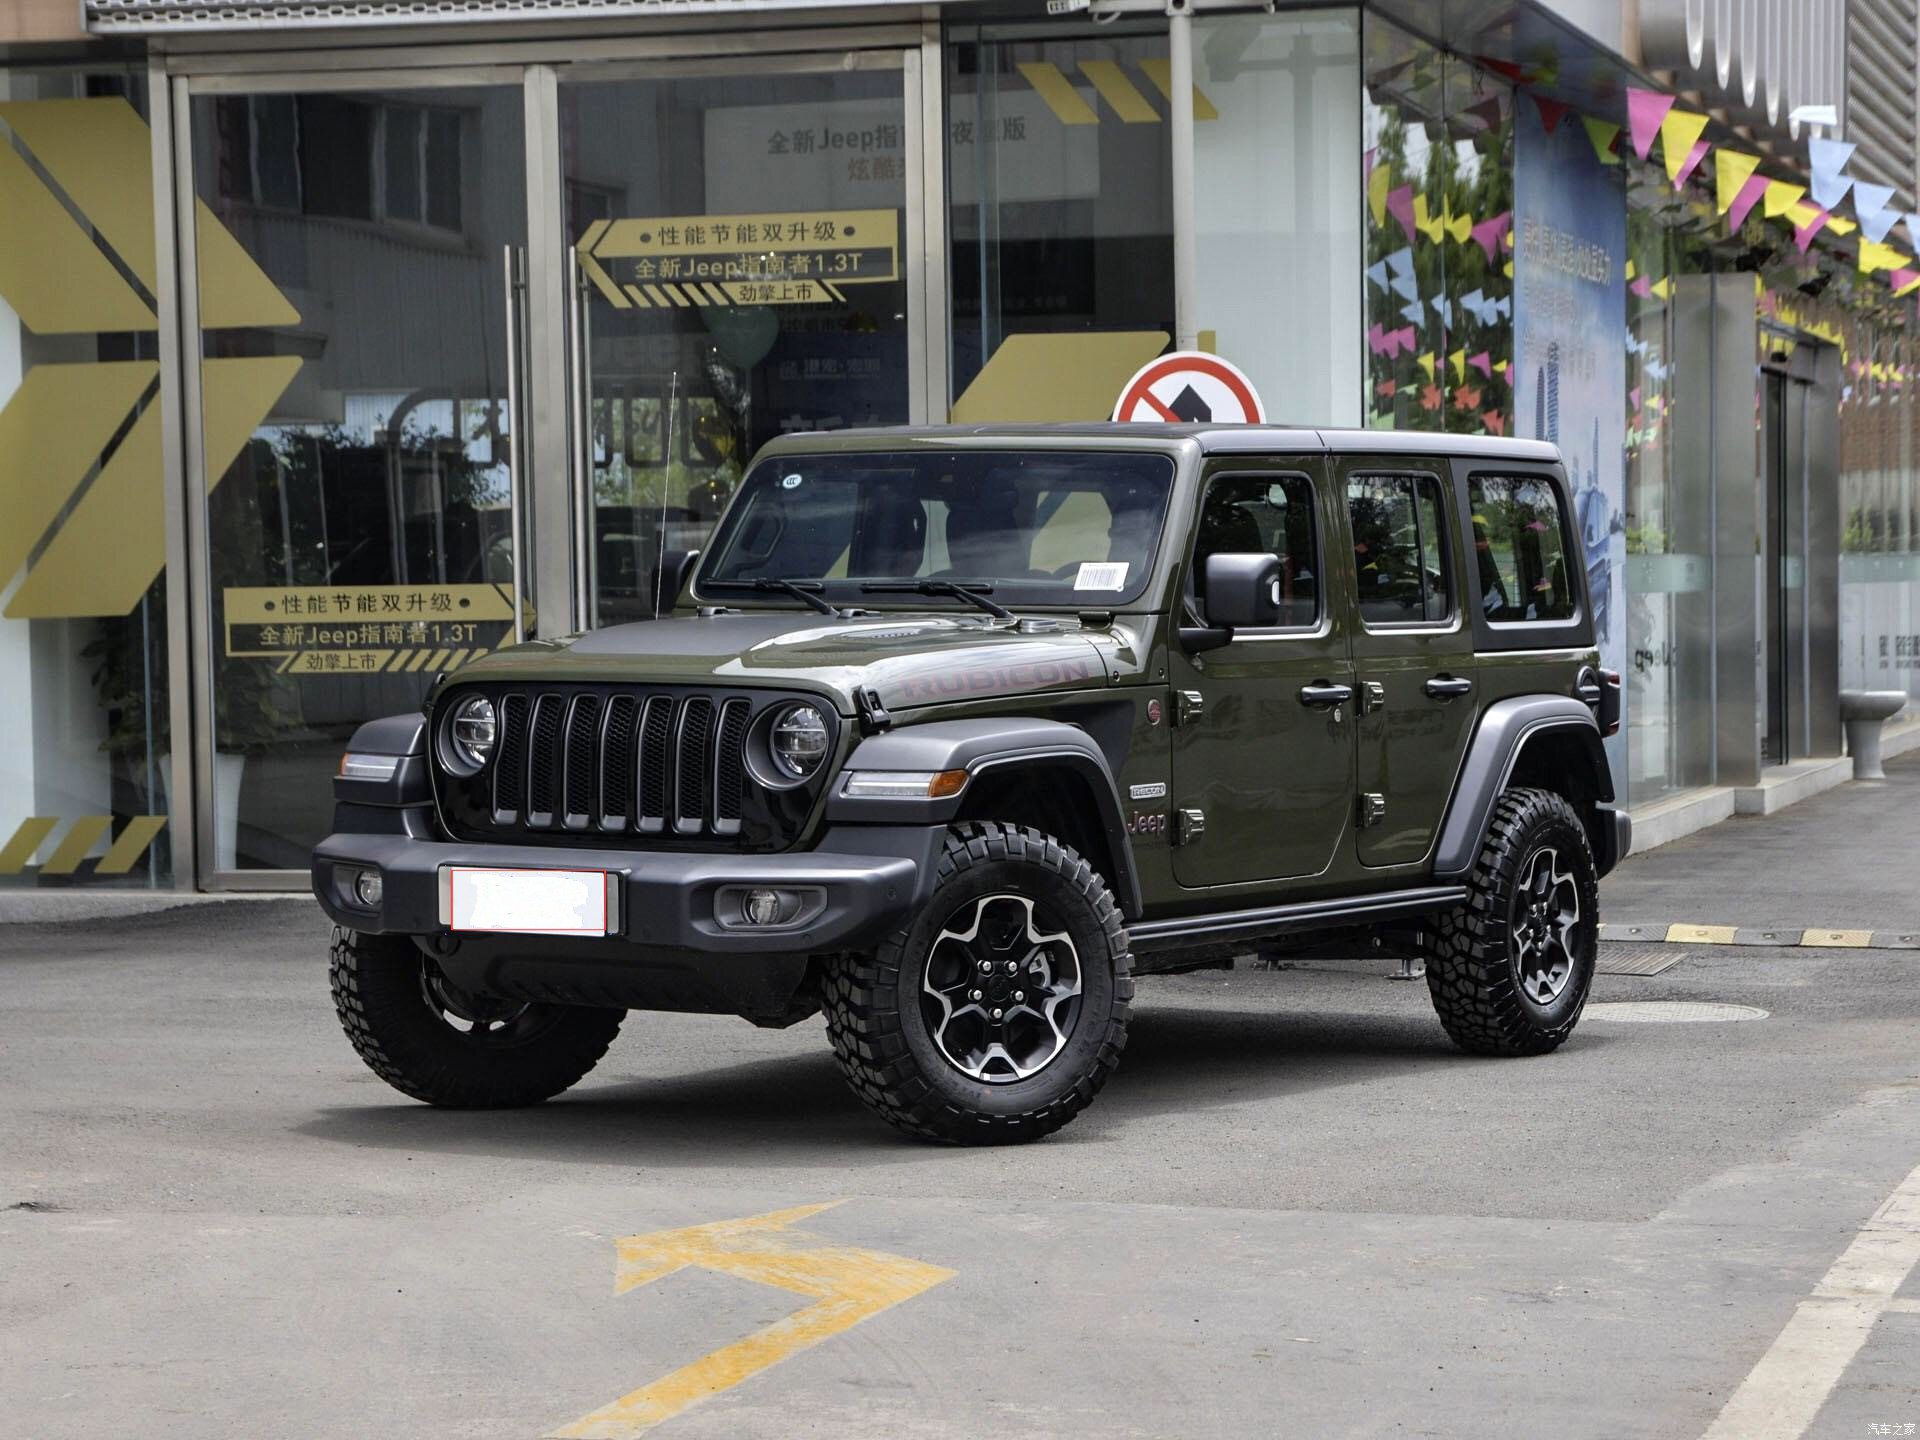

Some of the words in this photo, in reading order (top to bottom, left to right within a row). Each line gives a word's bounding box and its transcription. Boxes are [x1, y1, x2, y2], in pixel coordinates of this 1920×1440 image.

[657, 221, 836, 246] 性能节能双升级
[635, 252, 863, 280] 全新Jeep指南者1.3T
[739, 283, 813, 302] 劲擎上市
[281, 592, 452, 615] 性能节能双升级
[259, 623, 478, 648] 全新Jeep指南者1.3T
[305, 652, 377, 672] 劲擎上市
[902, 661, 1090, 697] RUBICON
[1133, 785, 1165, 797] RECON
[1127, 810, 1167, 836] Jeep
